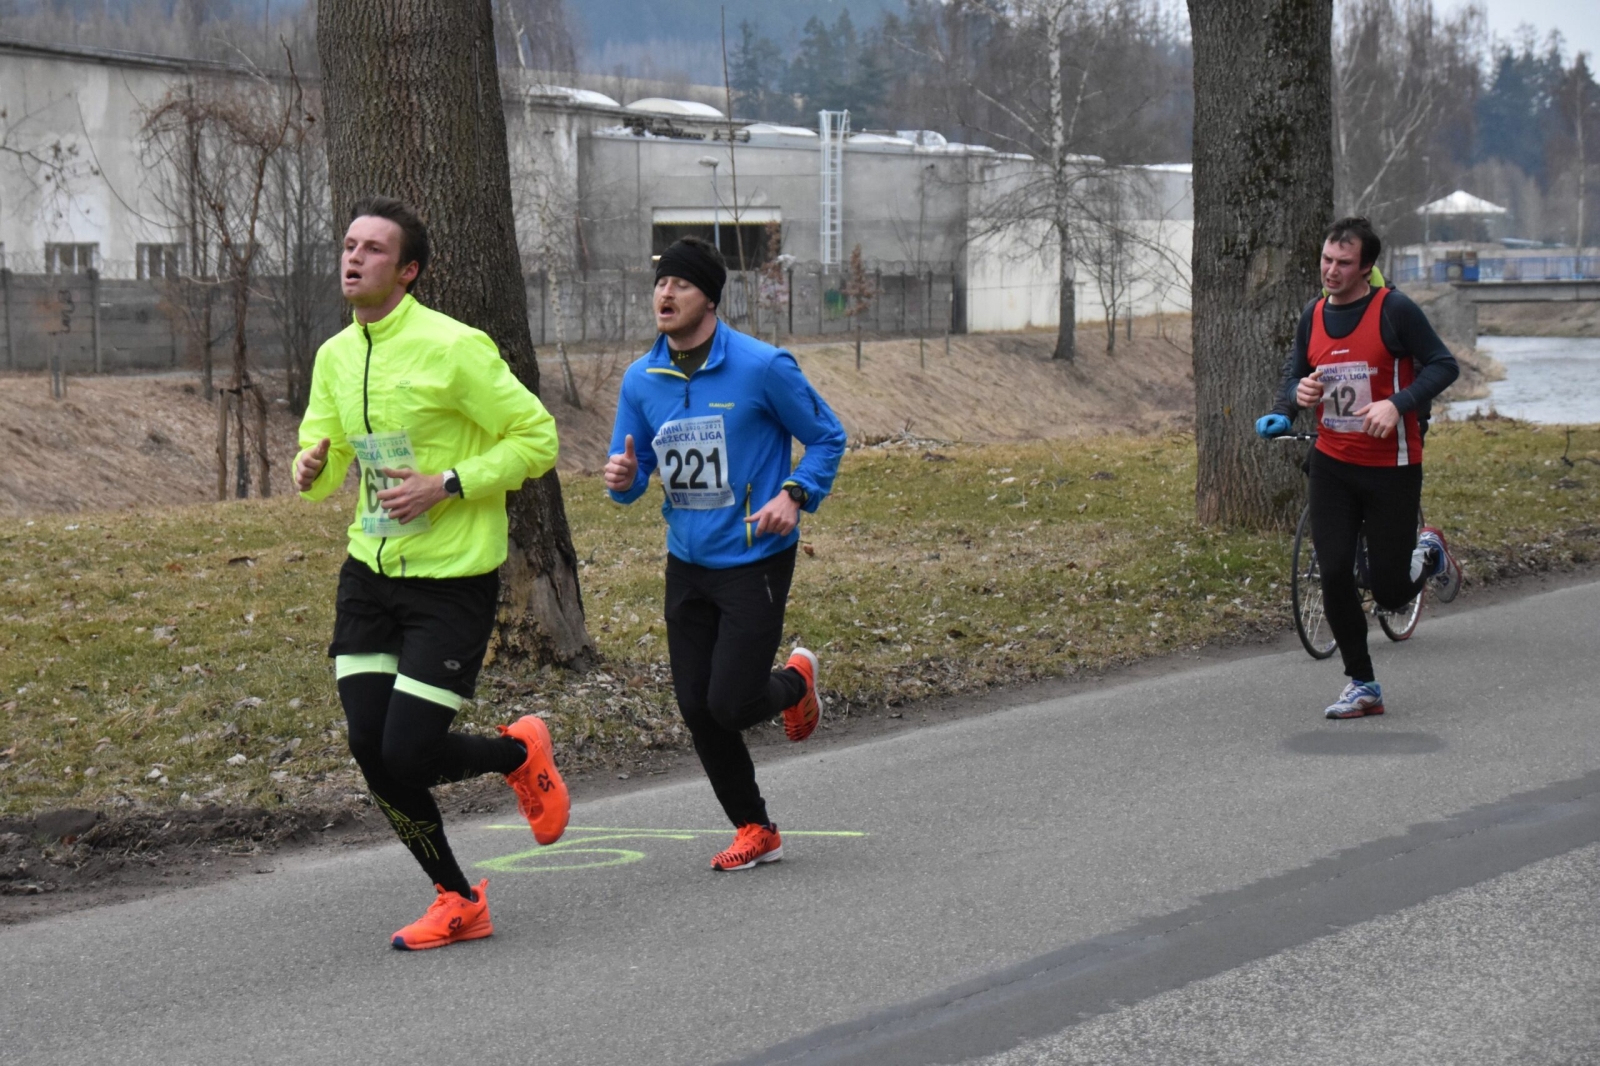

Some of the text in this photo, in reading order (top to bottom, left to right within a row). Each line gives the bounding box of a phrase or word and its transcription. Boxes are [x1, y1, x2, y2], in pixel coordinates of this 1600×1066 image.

[1350, 372, 1368, 380] LIGA
[1330, 386, 1356, 416] 12
[700, 431, 722, 441] LIGA
[387, 447, 411, 459] LIGA
[665, 447, 723, 489] 221
